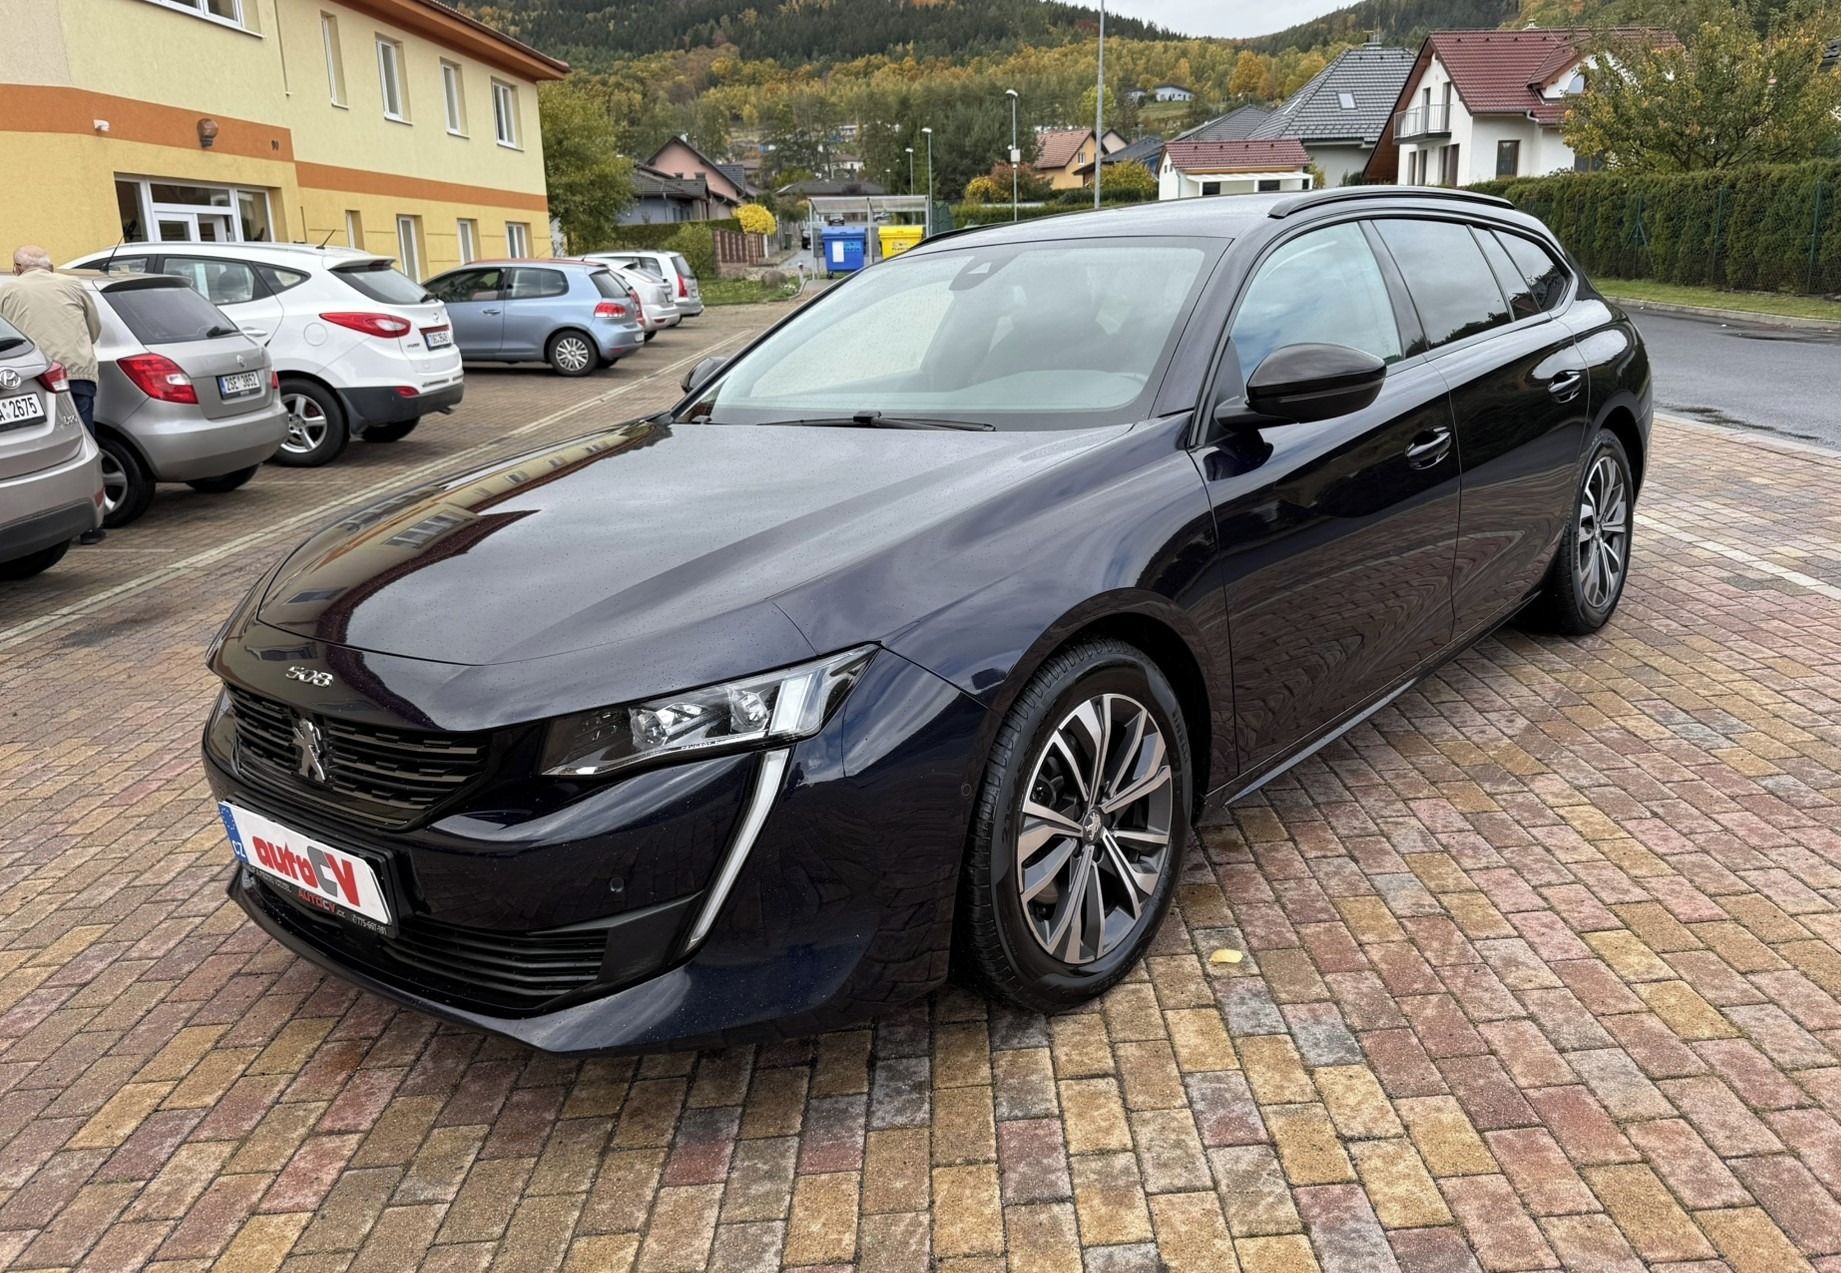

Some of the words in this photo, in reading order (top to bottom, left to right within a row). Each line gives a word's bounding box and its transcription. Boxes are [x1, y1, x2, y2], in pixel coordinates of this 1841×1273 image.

[9, 397, 37, 418] 2675
[285, 666, 333, 687] 508
[232, 840, 246, 858] CZ
